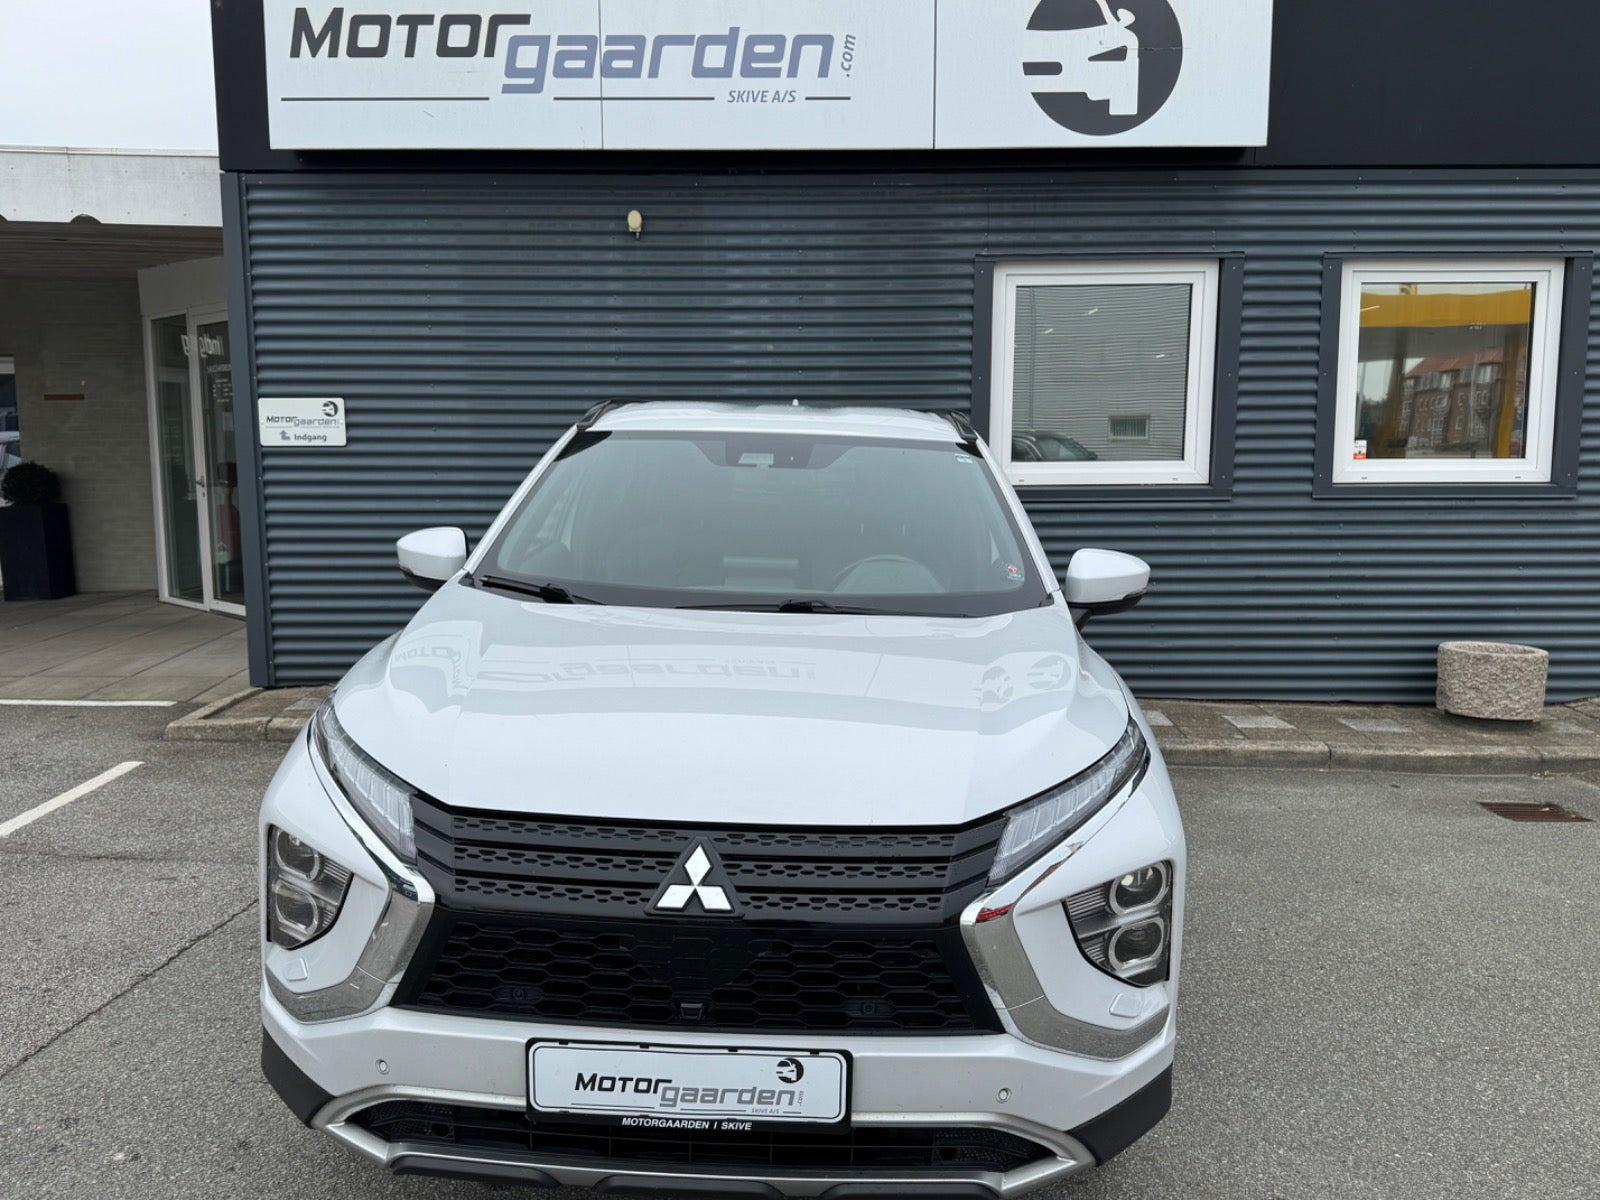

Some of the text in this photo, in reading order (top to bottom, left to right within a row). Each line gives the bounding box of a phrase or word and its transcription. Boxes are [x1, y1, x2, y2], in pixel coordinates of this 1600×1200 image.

[727, 89, 796, 103] SKIVE A/S
[294, 433, 327, 443] Indgang
[622, 1117, 709, 1130] MOTORGAARDEN
[721, 1120, 752, 1131] SKIVE
